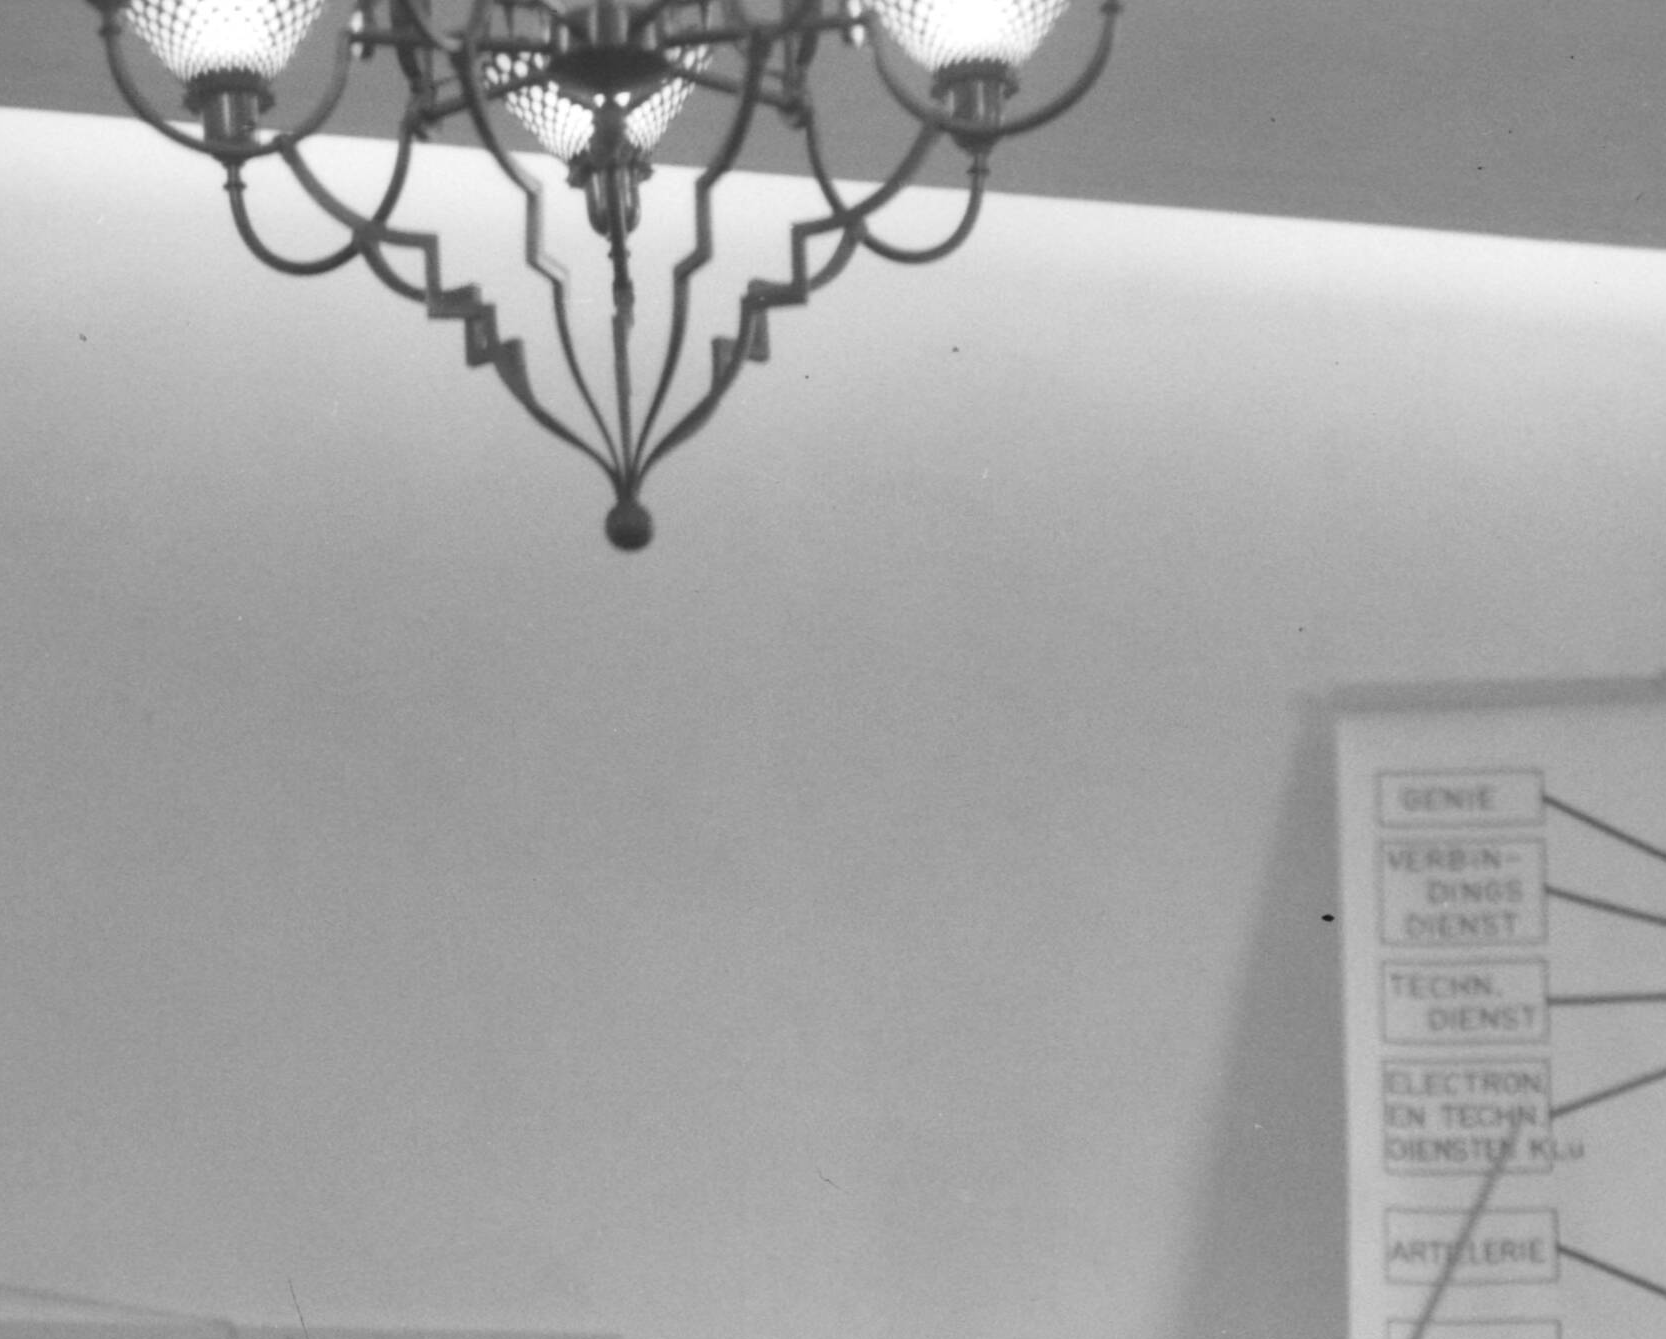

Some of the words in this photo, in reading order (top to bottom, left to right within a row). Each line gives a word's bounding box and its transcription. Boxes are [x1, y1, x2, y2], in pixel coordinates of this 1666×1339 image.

[1401, 785, 1497, 812] GENIE
[1427, 879, 1524, 905] DINGS
[1404, 912, 1521, 939] DIENST
[1428, 1007, 1536, 1032] DIENST
[1389, 1236, 1546, 1266] ARTLERIE
